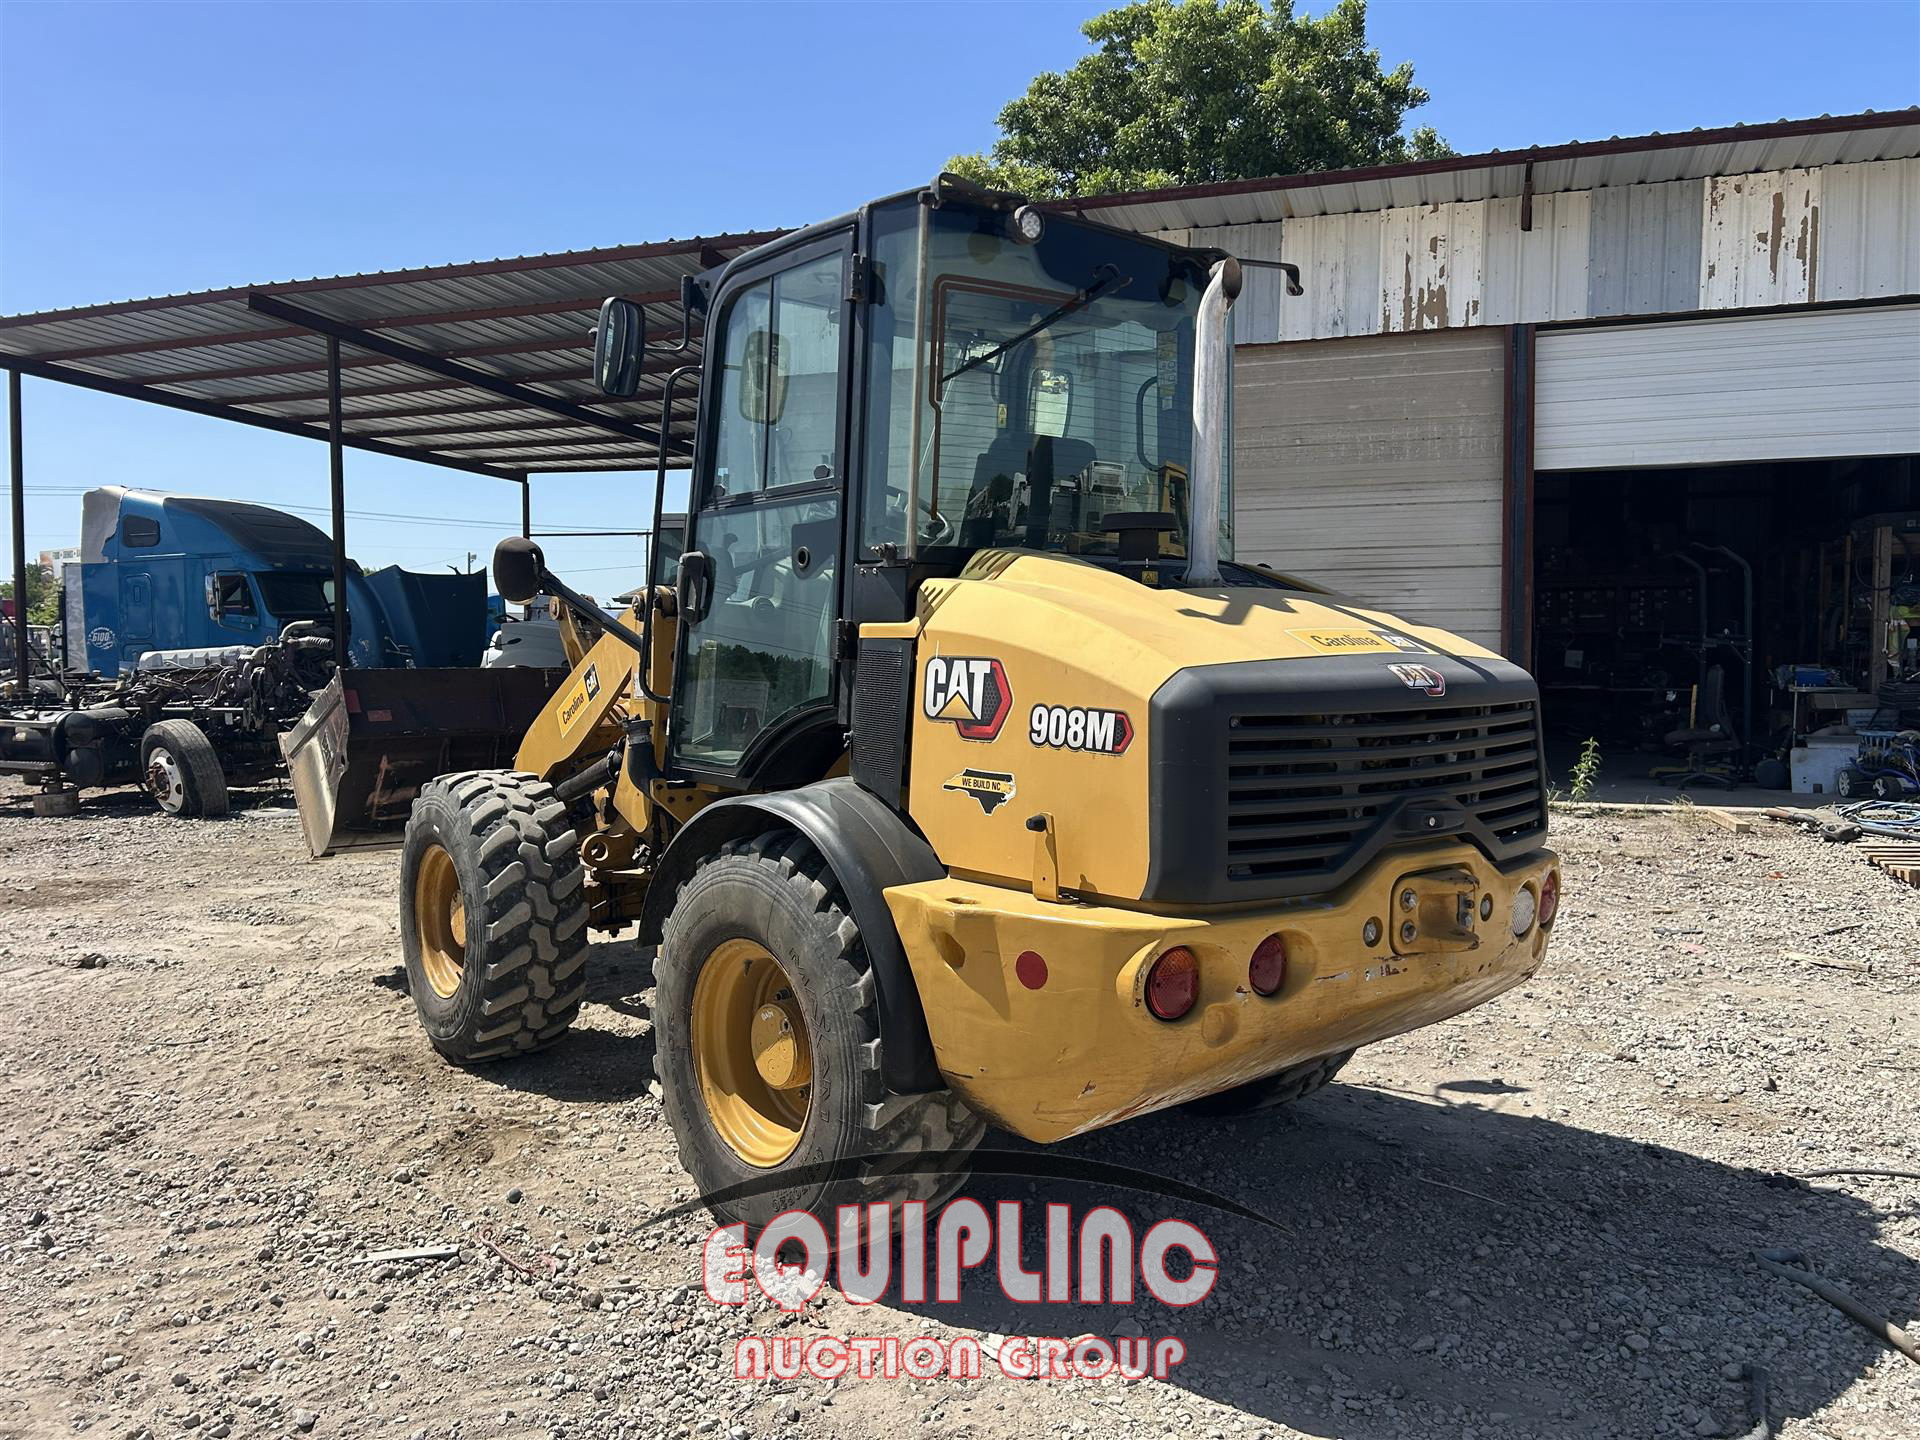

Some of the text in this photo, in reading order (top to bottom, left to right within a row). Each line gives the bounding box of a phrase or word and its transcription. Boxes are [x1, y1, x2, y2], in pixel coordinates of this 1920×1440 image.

[1310, 633, 1382, 647] Carolina
[1387, 663, 1435, 687] CAT
[926, 658, 991, 720] CAT
[563, 693, 584, 724] Carolina
[1031, 705, 1116, 752] 908M
[961, 777, 1001, 791] WE BUILD NC
